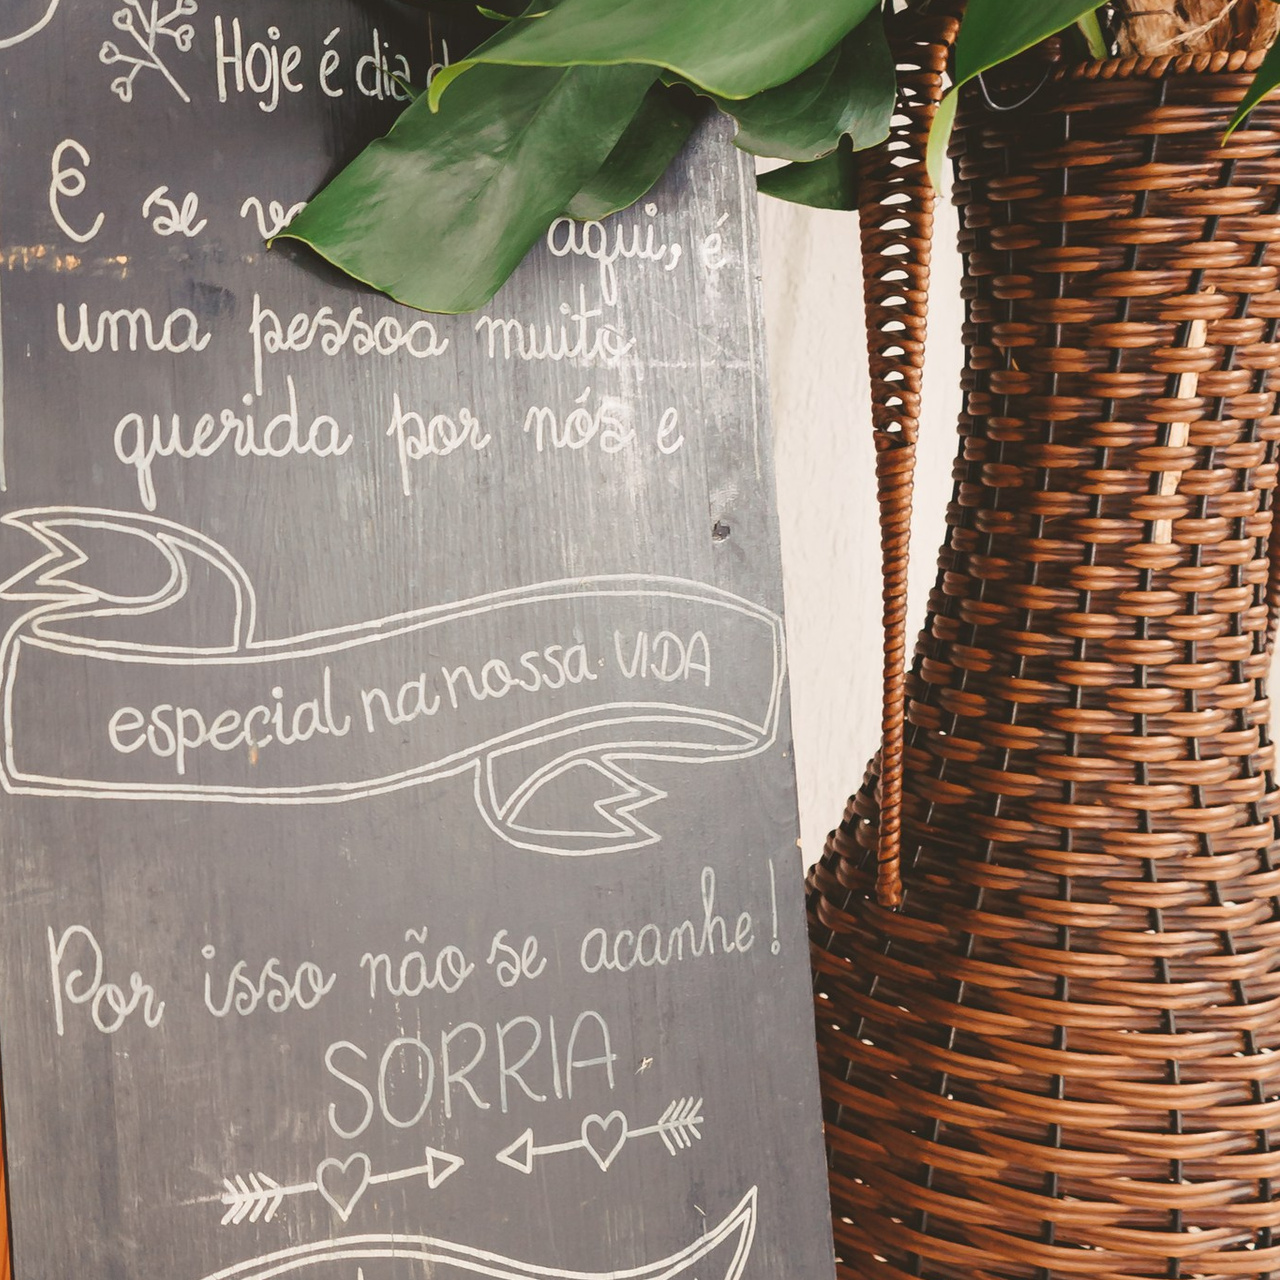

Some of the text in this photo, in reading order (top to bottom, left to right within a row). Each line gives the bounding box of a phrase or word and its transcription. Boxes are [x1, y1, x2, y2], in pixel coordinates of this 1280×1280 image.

[214, 15, 303, 112] Hoje
[320, 26, 344, 98] é
[355, 27, 414, 101] dia
[49, 138, 105, 243] E
[142, 185, 208, 238] se
[547, 202, 682, 306] aqui,
[700, 212, 730, 270] é
[57, 283, 638, 396] uma pessoa muito
[114, 376, 685, 512] querida por nós e
[108, 629, 713, 775] especial na nossa VIDA
[47, 858, 783, 1036] Por isso não se acanhe!
[325, 1009, 619, 1140] SORRIA
